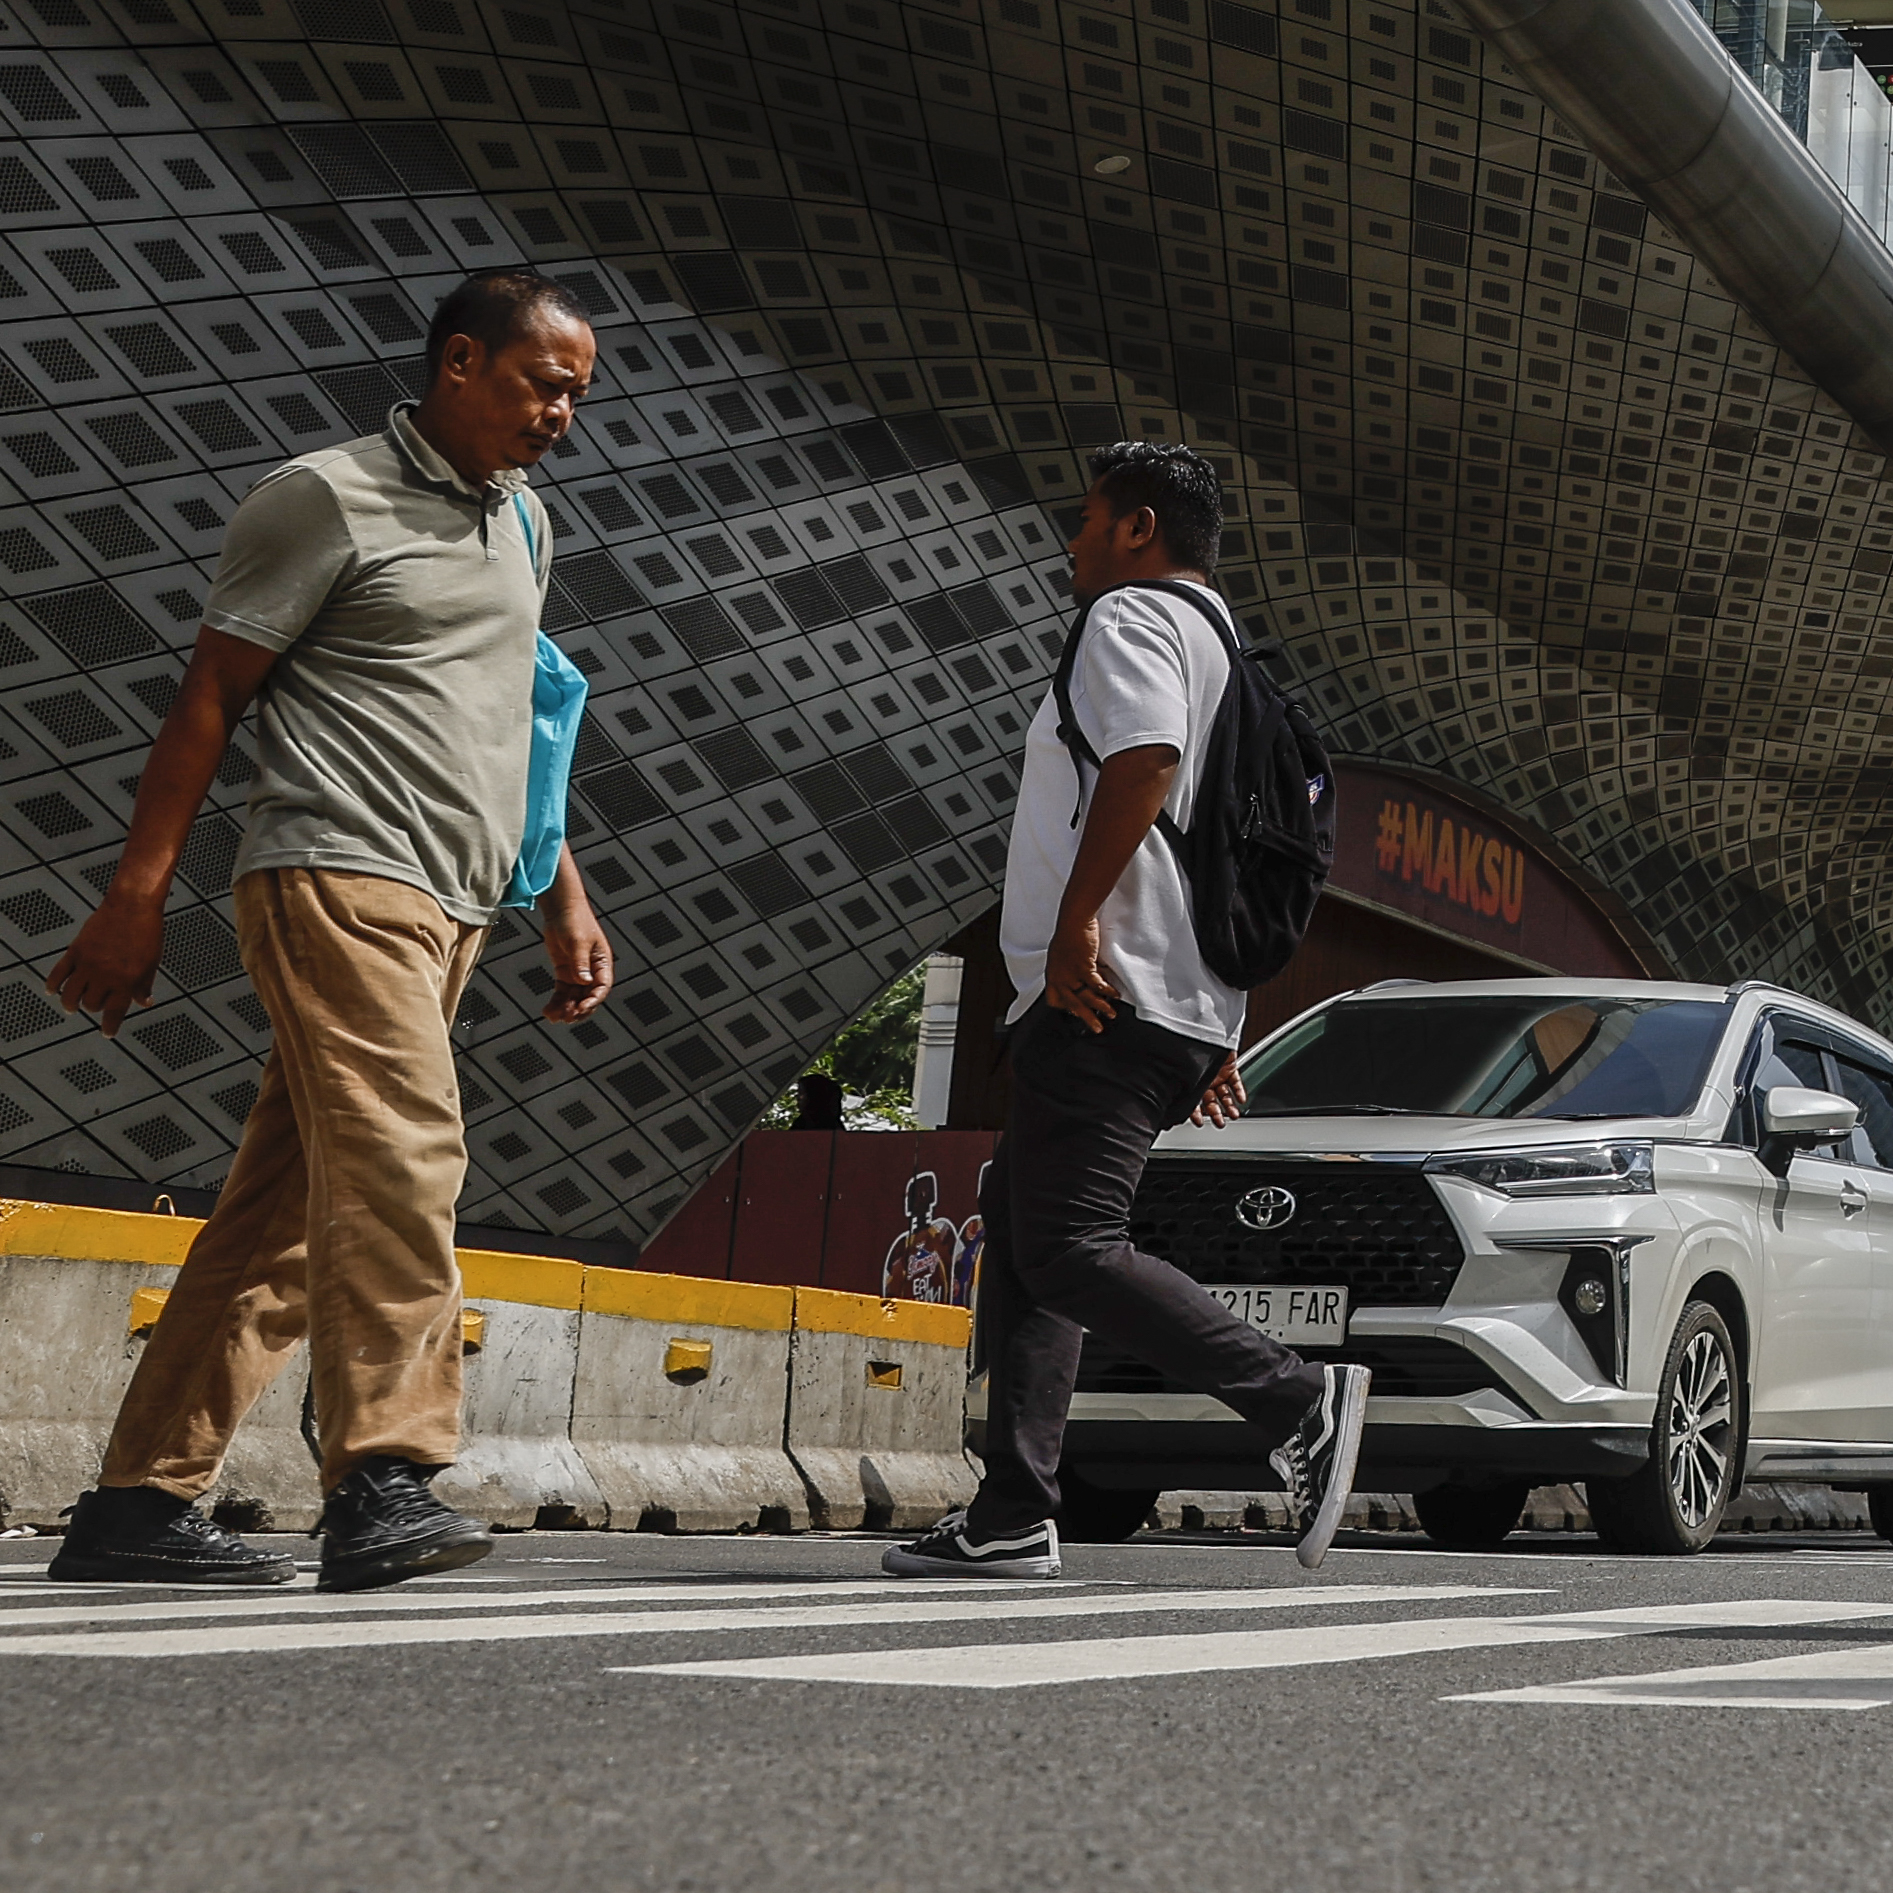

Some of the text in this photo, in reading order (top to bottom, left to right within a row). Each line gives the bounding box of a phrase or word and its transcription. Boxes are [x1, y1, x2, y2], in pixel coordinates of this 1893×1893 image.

[1375, 799, 1525, 925] #MAKSU
[912, 1274, 933, 1296] EAT
[1209, 1290, 1338, 1325] 215 FAR
